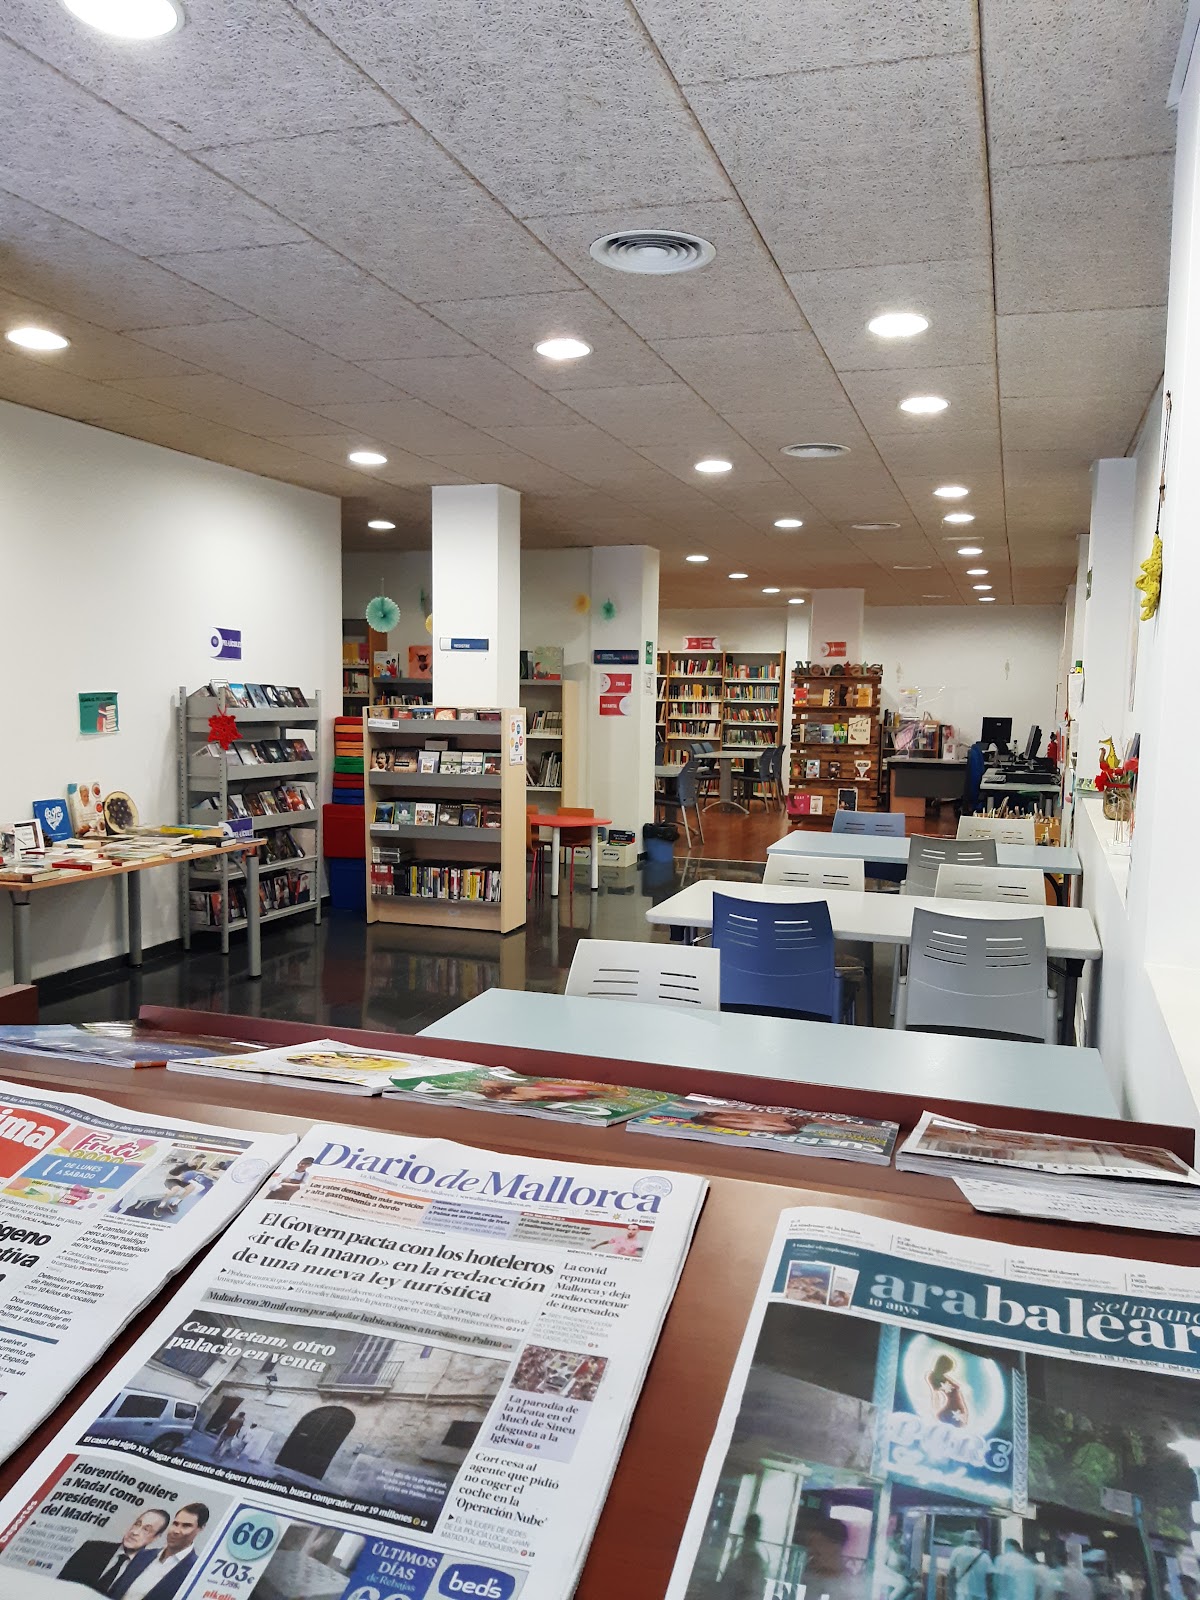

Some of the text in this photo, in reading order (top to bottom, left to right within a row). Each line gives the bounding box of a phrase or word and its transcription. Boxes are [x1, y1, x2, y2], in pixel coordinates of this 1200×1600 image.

[795, 660, 883, 677] Novetats
[42, 1102, 65, 1112] renuncia
[90, 1117, 115, 1127] diputado
[63, 1169, 96, 1180] SÁBADO
[77, 1163, 103, 1173] LUNES
[311, 1142, 436, 1186] Diario
[436, 1168, 480, 1193] de
[479, 1170, 662, 1214] Mallorca
[325, 1191, 371, 1207] gastronomía
[341, 1187, 377, 1200] demandan
[84, 1230, 101, 1238] pero
[103, 1225, 128, 1235] cambia
[91, 1238, 120, 1248] haberme
[120, 1243, 149, 1253] quedado
[91, 1245, 103, 1253] voy
[258, 1212, 279, 1227] El
[279, 1215, 345, 1242] Govern
[343, 1231, 398, 1252] pacta
[399, 1241, 435, 1257] con
[433, 1245, 464, 1262] los
[463, 1247, 555, 1275] hoteleros
[0, 1247, 40, 1268] tiva
[275, 1235, 300, 1251] de
[303, 1239, 320, 1254] la
[392, 1260, 419, 1273] en
[420, 1261, 441, 1276] la
[442, 1266, 546, 1294] redacción
[231, 1247, 257, 1264] de
[260, 1255, 300, 1272] una
[303, 1264, 366, 1283] nueva
[368, 1270, 401, 1291] ley
[402, 1277, 492, 1303] turística
[563, 1262, 608, 1275] La covid
[37, 1271, 104, 1290] Detenido puerto
[40, 1280, 104, 1298] Palma camionero
[560, 1273, 601, 1286] repunta
[45, 1288, 61, 1297] kilos
[70, 1295, 97, 1305] cocaína
[550, 1291, 629, 1309] medio centenar
[555, 1282, 631, 1300] Mallorca deja
[4, 1303, 24, 1313] raptar
[42, 1313, 62, 1322] mujer
[10, 1295, 73, 1316] Dos arrestados por
[560, 1302, 620, 1318] ingresados
[869, 1297, 920, 1317] 10 anys
[0, 1310, 69, 1331] Palma abusar ella
[208, 1291, 502, 1348] Multado con 20 mil euros por alquilar habitaciones turistas en Palma
[182, 1320, 336, 1358] Can Uetam, otro
[165, 1336, 327, 1374] palacio en venta
[504, 1403, 514, 1412] la
[515, 1405, 545, 1418] Beata
[561, 1415, 572, 1424] el
[509, 1394, 579, 1414] La parodia de
[494, 1423, 559, 1443] disgusta la
[500, 1413, 576, 1435] Much de Sineu
[490, 1433, 525, 1447] Iglesia
[475, 1452, 537, 1472] Cort cesa al
[73, 1463, 179, 1502] Florentino quiere
[89, 1437, 413, 1524] casal del siglo XV, hogar del cantante de ópera homónimo, busca comprador por 19 millones
[464, 1474, 525, 1494] no coger el
[469, 1463, 559, 1490] agente que pidió
[51, 1490, 119, 1514] presidente
[63, 1477, 145, 1507] a Nadal como
[459, 1486, 520, 1507] coche en la
[41, 1503, 110, 1528] del Madrid
[232, 1522, 274, 1550] 60
[371, 1540, 438, 1569] ÚLTIMOS
[378, 1560, 416, 1581] DÍAS
